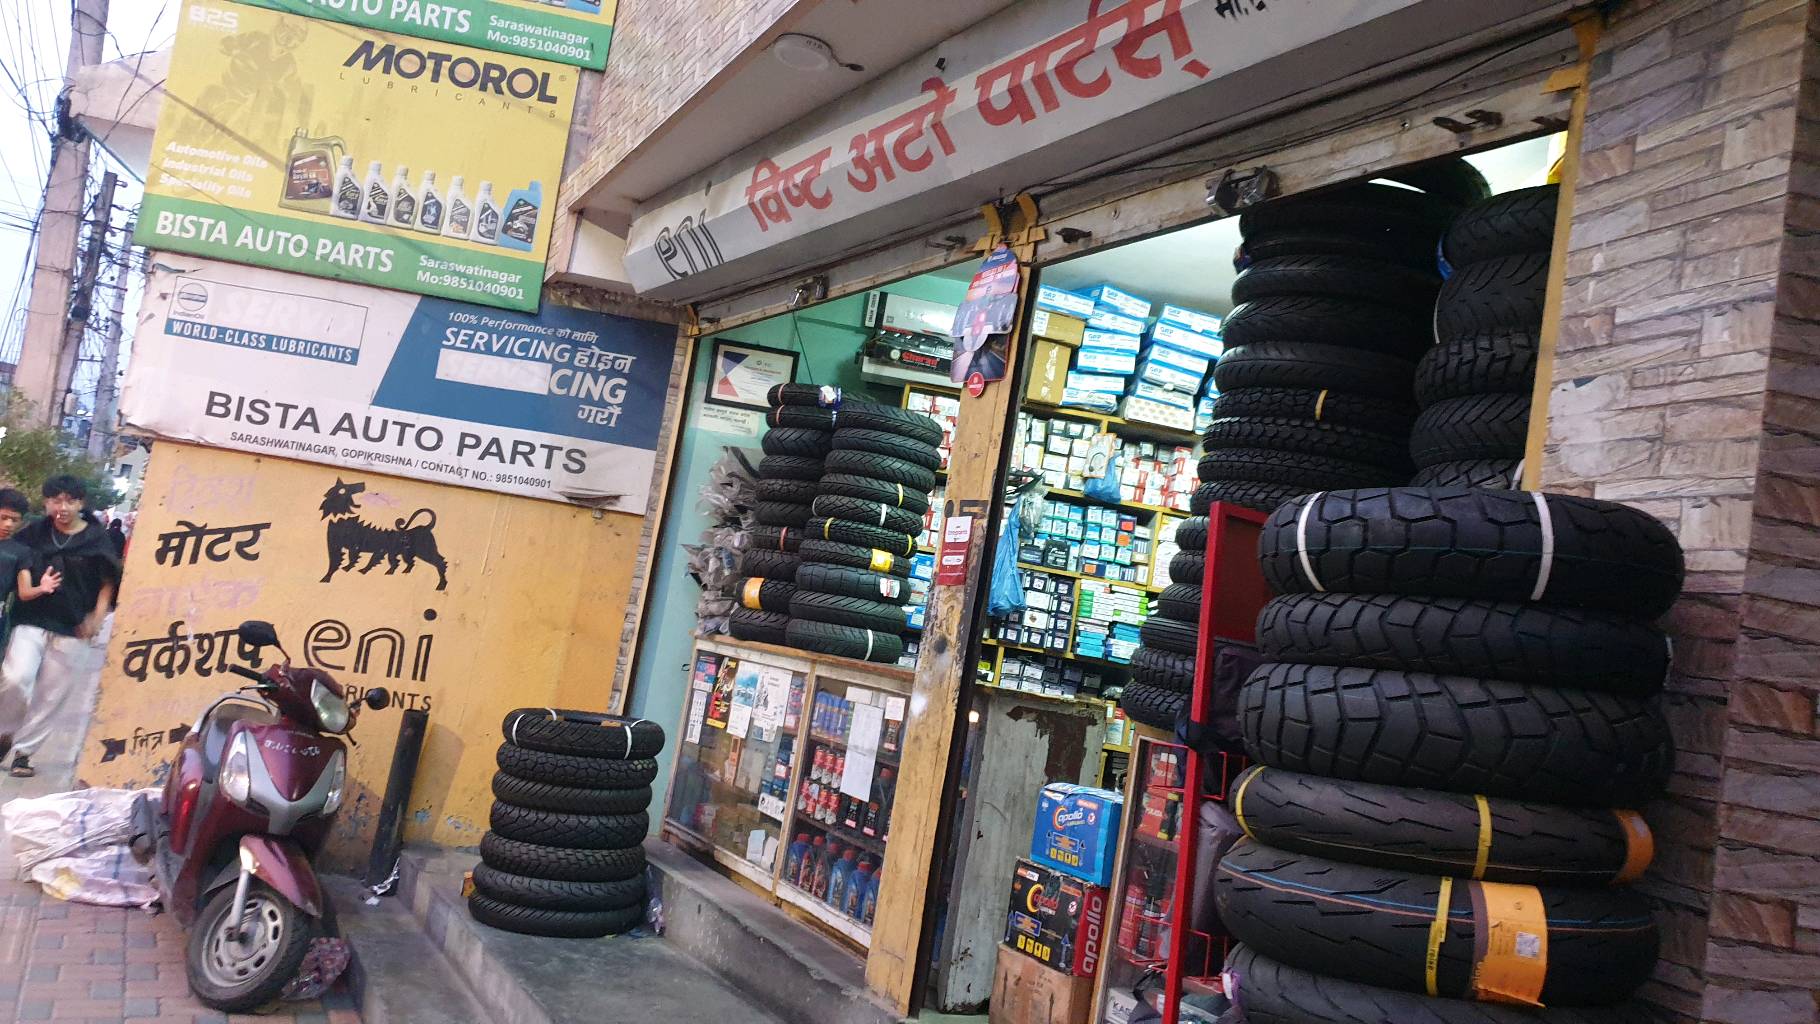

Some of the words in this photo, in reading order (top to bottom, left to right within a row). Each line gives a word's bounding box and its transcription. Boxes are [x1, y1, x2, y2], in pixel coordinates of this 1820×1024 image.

[390, 0, 472, 33] PARTS
[489, 15, 589, 46] Saraswatinagar
[487, 29, 592, 61] Mo:9851040901
[342, 40, 558, 104] MOTOROL
[155, 210, 228, 245] BISTA
[235, 225, 309, 258] AUTO
[315, 238, 395, 273] PARTS
[416, 270, 525, 300] Mo:9851040901
[419, 254, 522, 285] Saraswatinagar
[172, 320, 266, 348] WORLD-CLASS
[272, 335, 353, 362] LUBRICANTS
[448, 311, 478, 325] 100%
[481, 315, 555, 336] Performance
[442, 327, 571, 363] SERVICING
[204, 390, 321, 434] BISTA
[329, 412, 443, 452] AUTO
[456, 431, 587, 475] PARTS
[230, 431, 338, 457] SARASHWATINAGAR,
[341, 448, 413, 468] GOPIKRISHNA
[421, 460, 469, 479] CONTACT
[495, 472, 551, 489] 9851040901
[303, 608, 437, 682] eni
[1082, 896, 1102, 974] apollo
